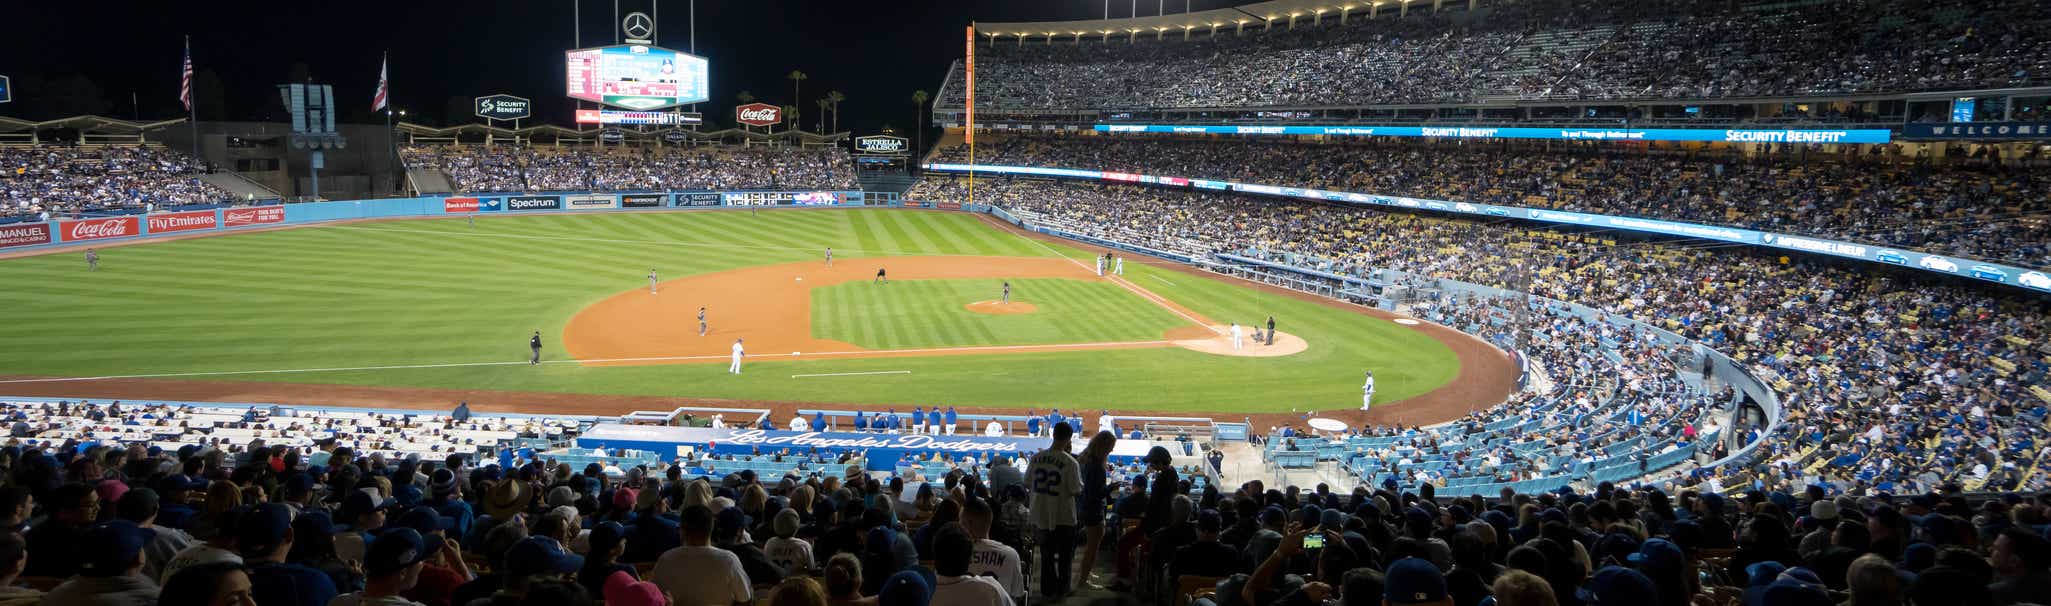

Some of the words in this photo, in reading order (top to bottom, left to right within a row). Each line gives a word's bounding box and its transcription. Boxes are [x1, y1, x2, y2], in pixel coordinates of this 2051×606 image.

[1421, 127, 1459, 137] SECURITY
[1459, 127, 1495, 137] BENEFIT
[1725, 129, 1785, 142] SECURITY
[1786, 130, 1841, 142] BENEFIT
[1932, 125, 2049, 135] WELCOME
[510, 199, 555, 209] Spectrum
[149, 218, 168, 229] Fly
[169, 215, 215, 227] Emirates
[0, 228, 46, 238] MANUEL
[729, 429, 767, 444] Los
[766, 432, 890, 447] Angeles
[889, 435, 1017, 451] Dodgers
[1034, 468, 1061, 497] 22
